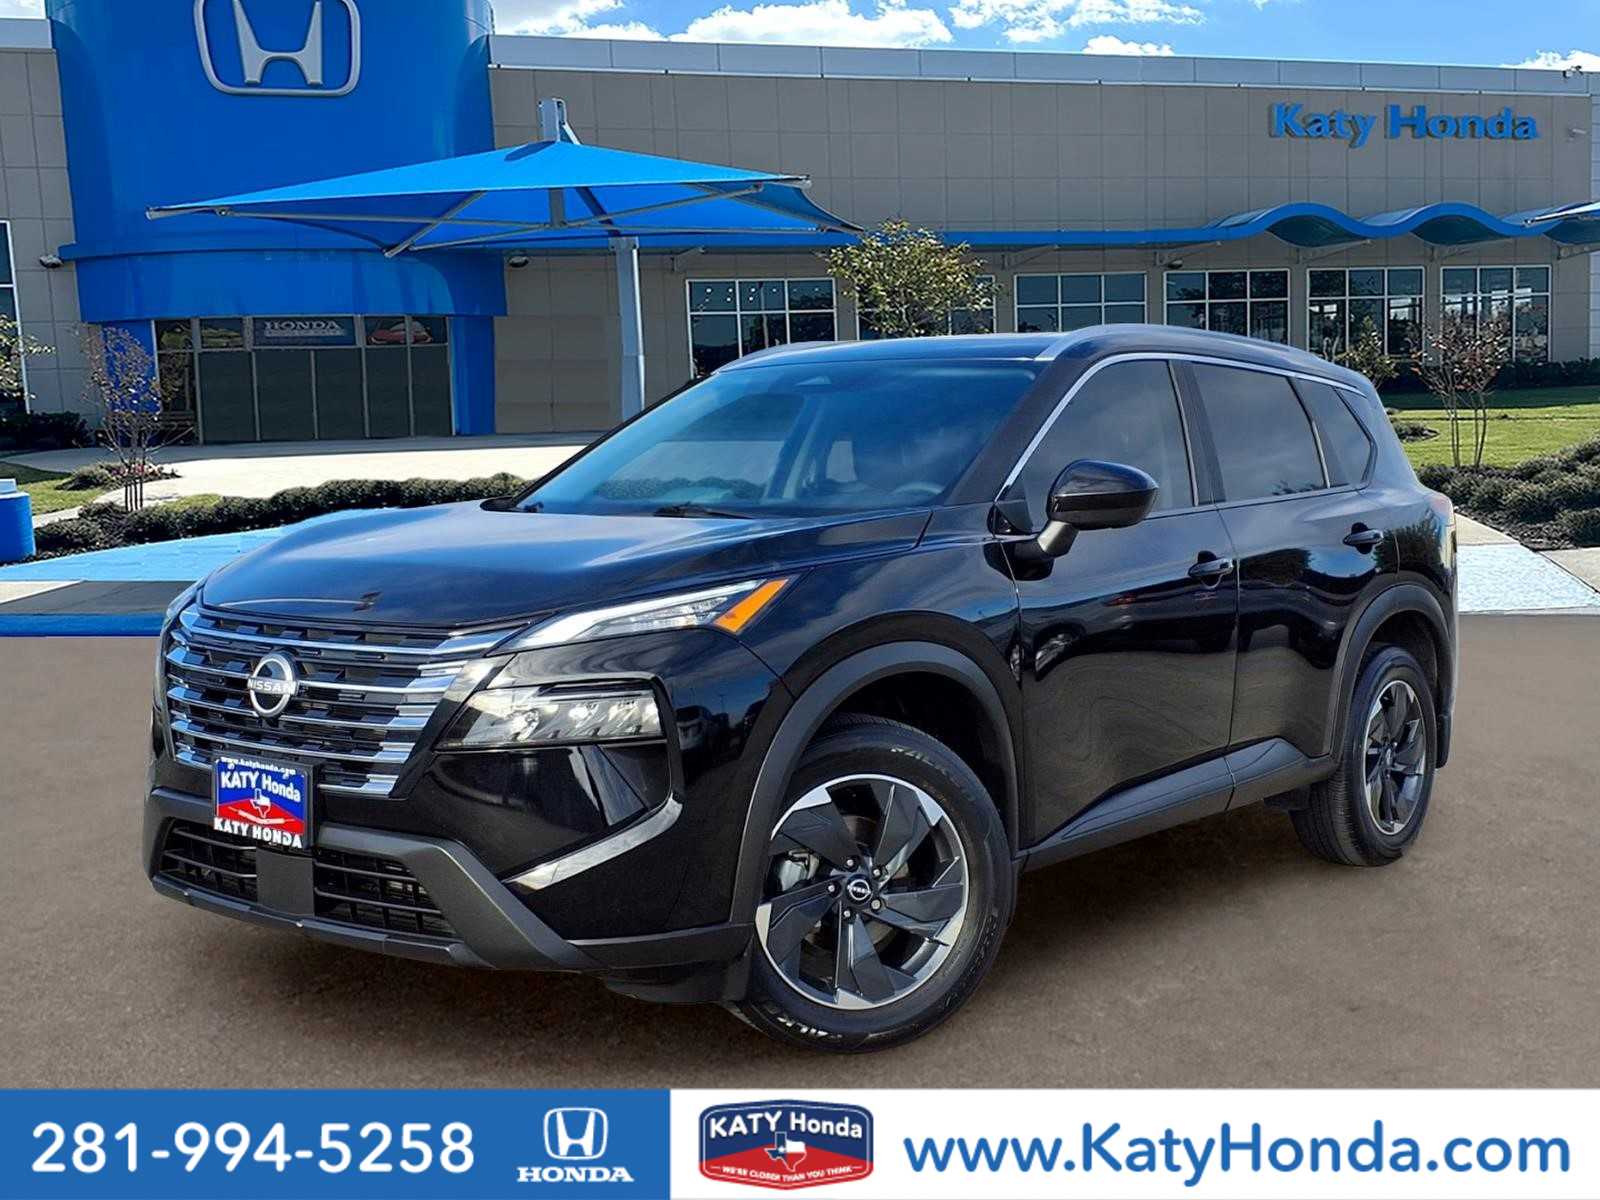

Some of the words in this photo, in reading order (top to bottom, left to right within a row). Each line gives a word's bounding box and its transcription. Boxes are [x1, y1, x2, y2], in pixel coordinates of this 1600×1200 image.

[1269, 103, 1376, 149] Katy
[1384, 104, 1540, 140] Honda
[264, 321, 343, 330] HONDA
[221, 771, 260, 789] KATY
[262, 773, 301, 803] Honda
[213, 816, 250, 837] KATY
[252, 825, 302, 849] HONDA
